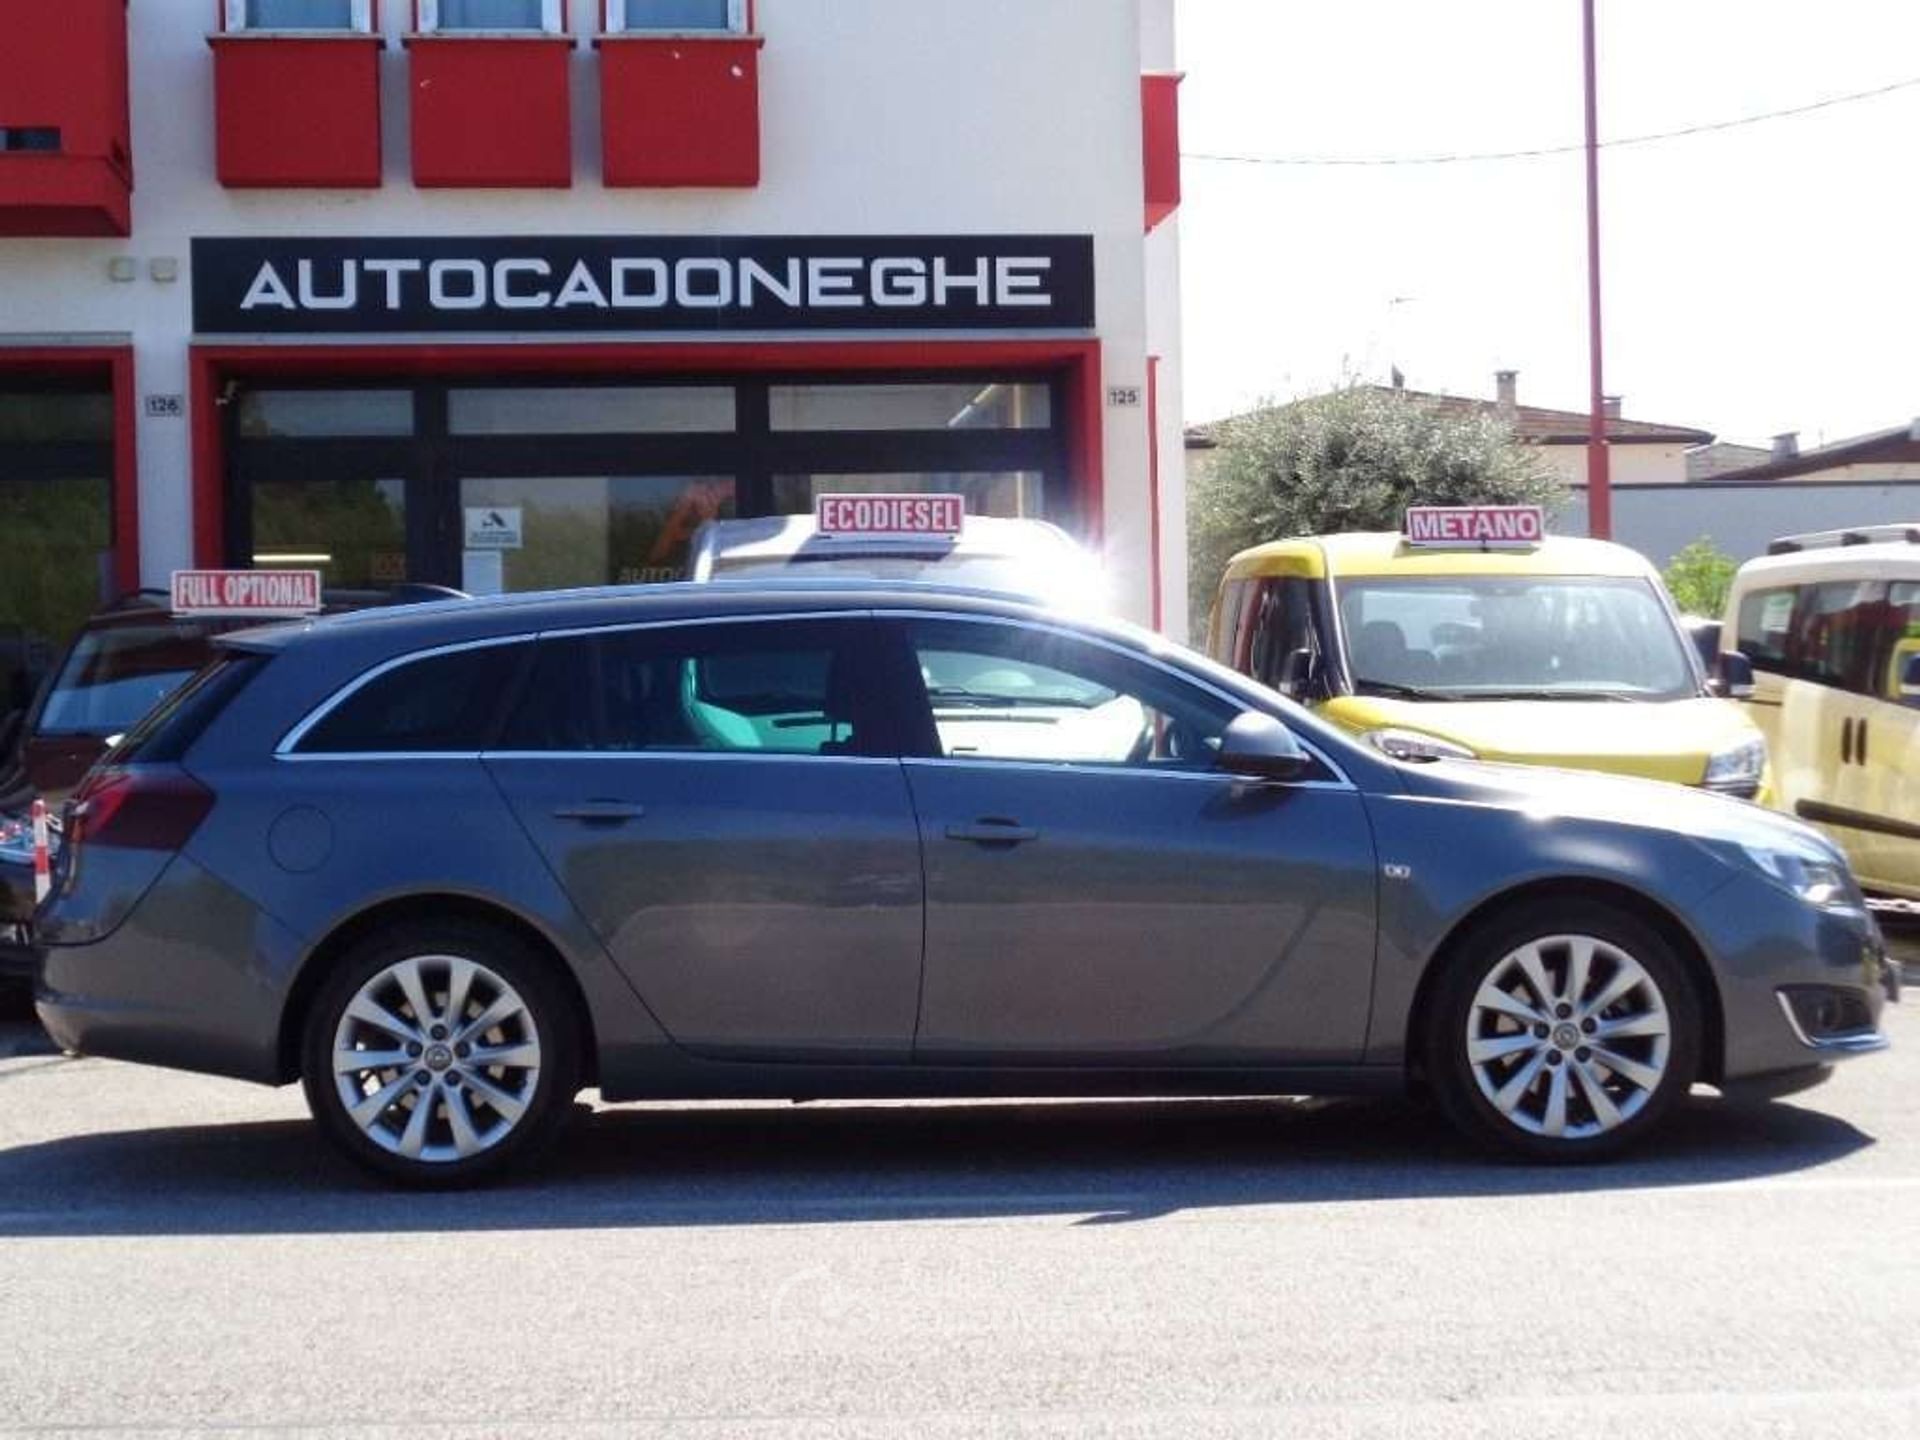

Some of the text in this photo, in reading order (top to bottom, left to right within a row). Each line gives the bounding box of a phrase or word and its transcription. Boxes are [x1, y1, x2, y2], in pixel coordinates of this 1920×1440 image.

[240, 256, 1052, 310] AUTOCADONEGHE
[1110, 389, 1137, 405] 125
[822, 500, 960, 531] ECODIESEL
[1411, 511, 1538, 540] METANO
[177, 575, 315, 606] FULL OPTIONAL
